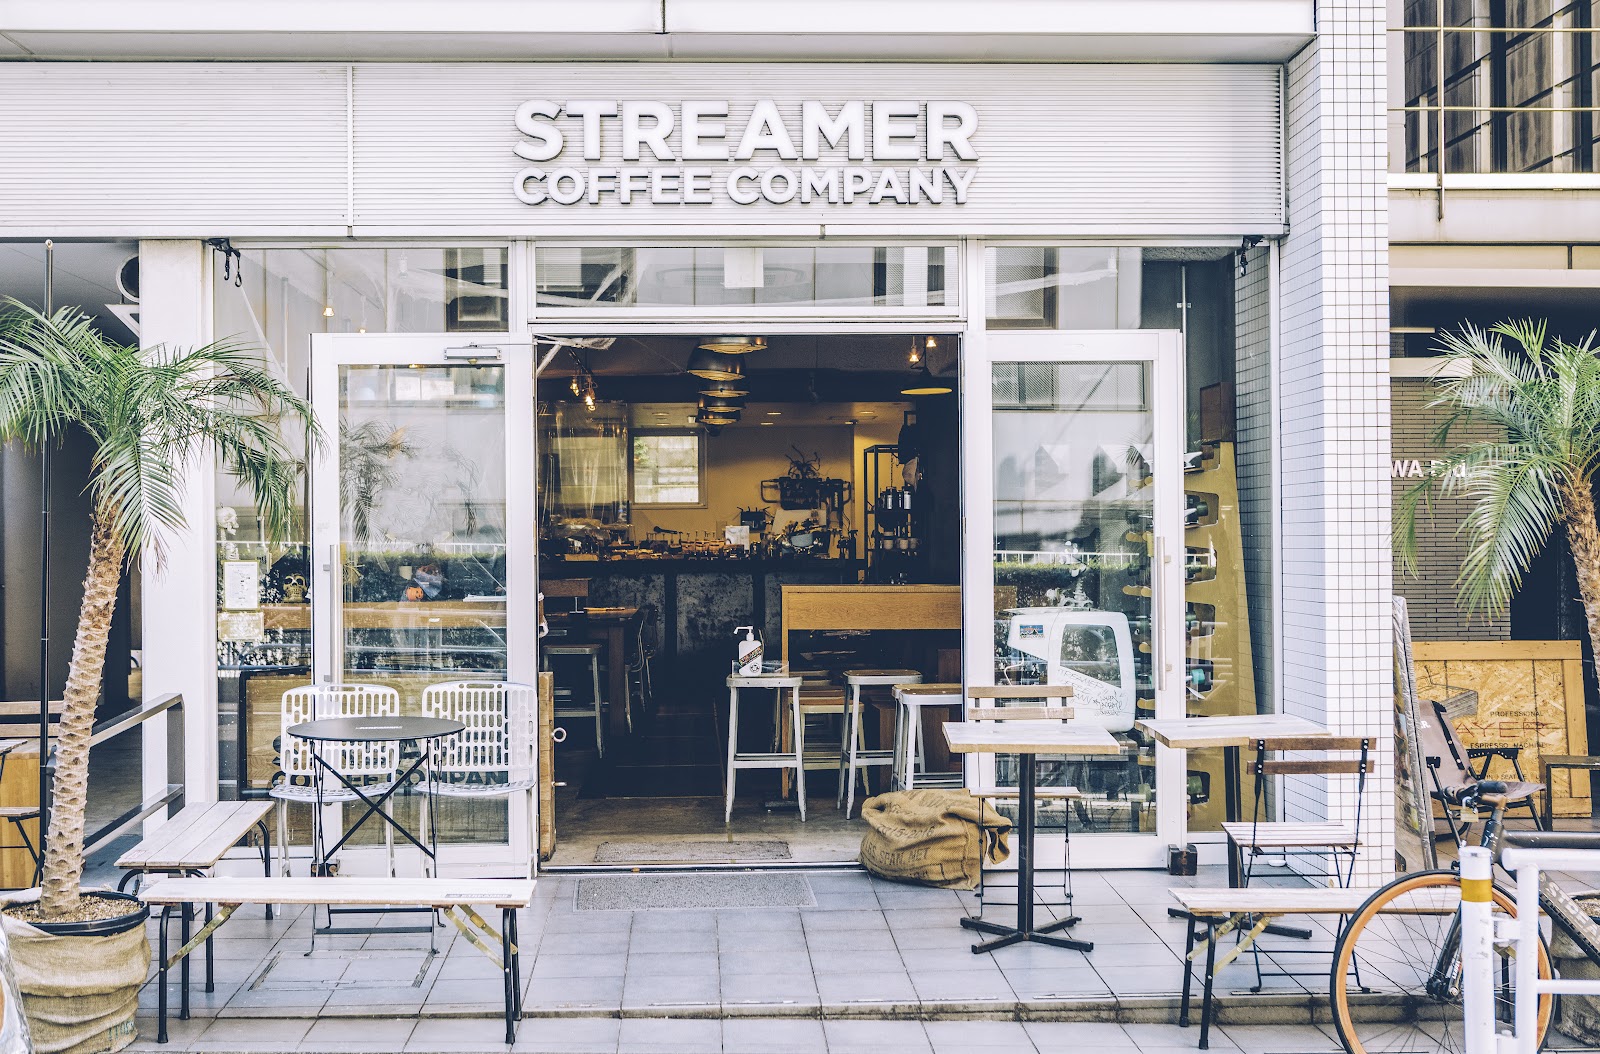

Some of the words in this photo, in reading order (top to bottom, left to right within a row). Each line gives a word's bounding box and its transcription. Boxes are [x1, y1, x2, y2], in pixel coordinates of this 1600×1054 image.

[512, 99, 979, 162] STREAMER
[512, 167, 714, 205] COFFEE
[726, 167, 979, 205] COMPANY
